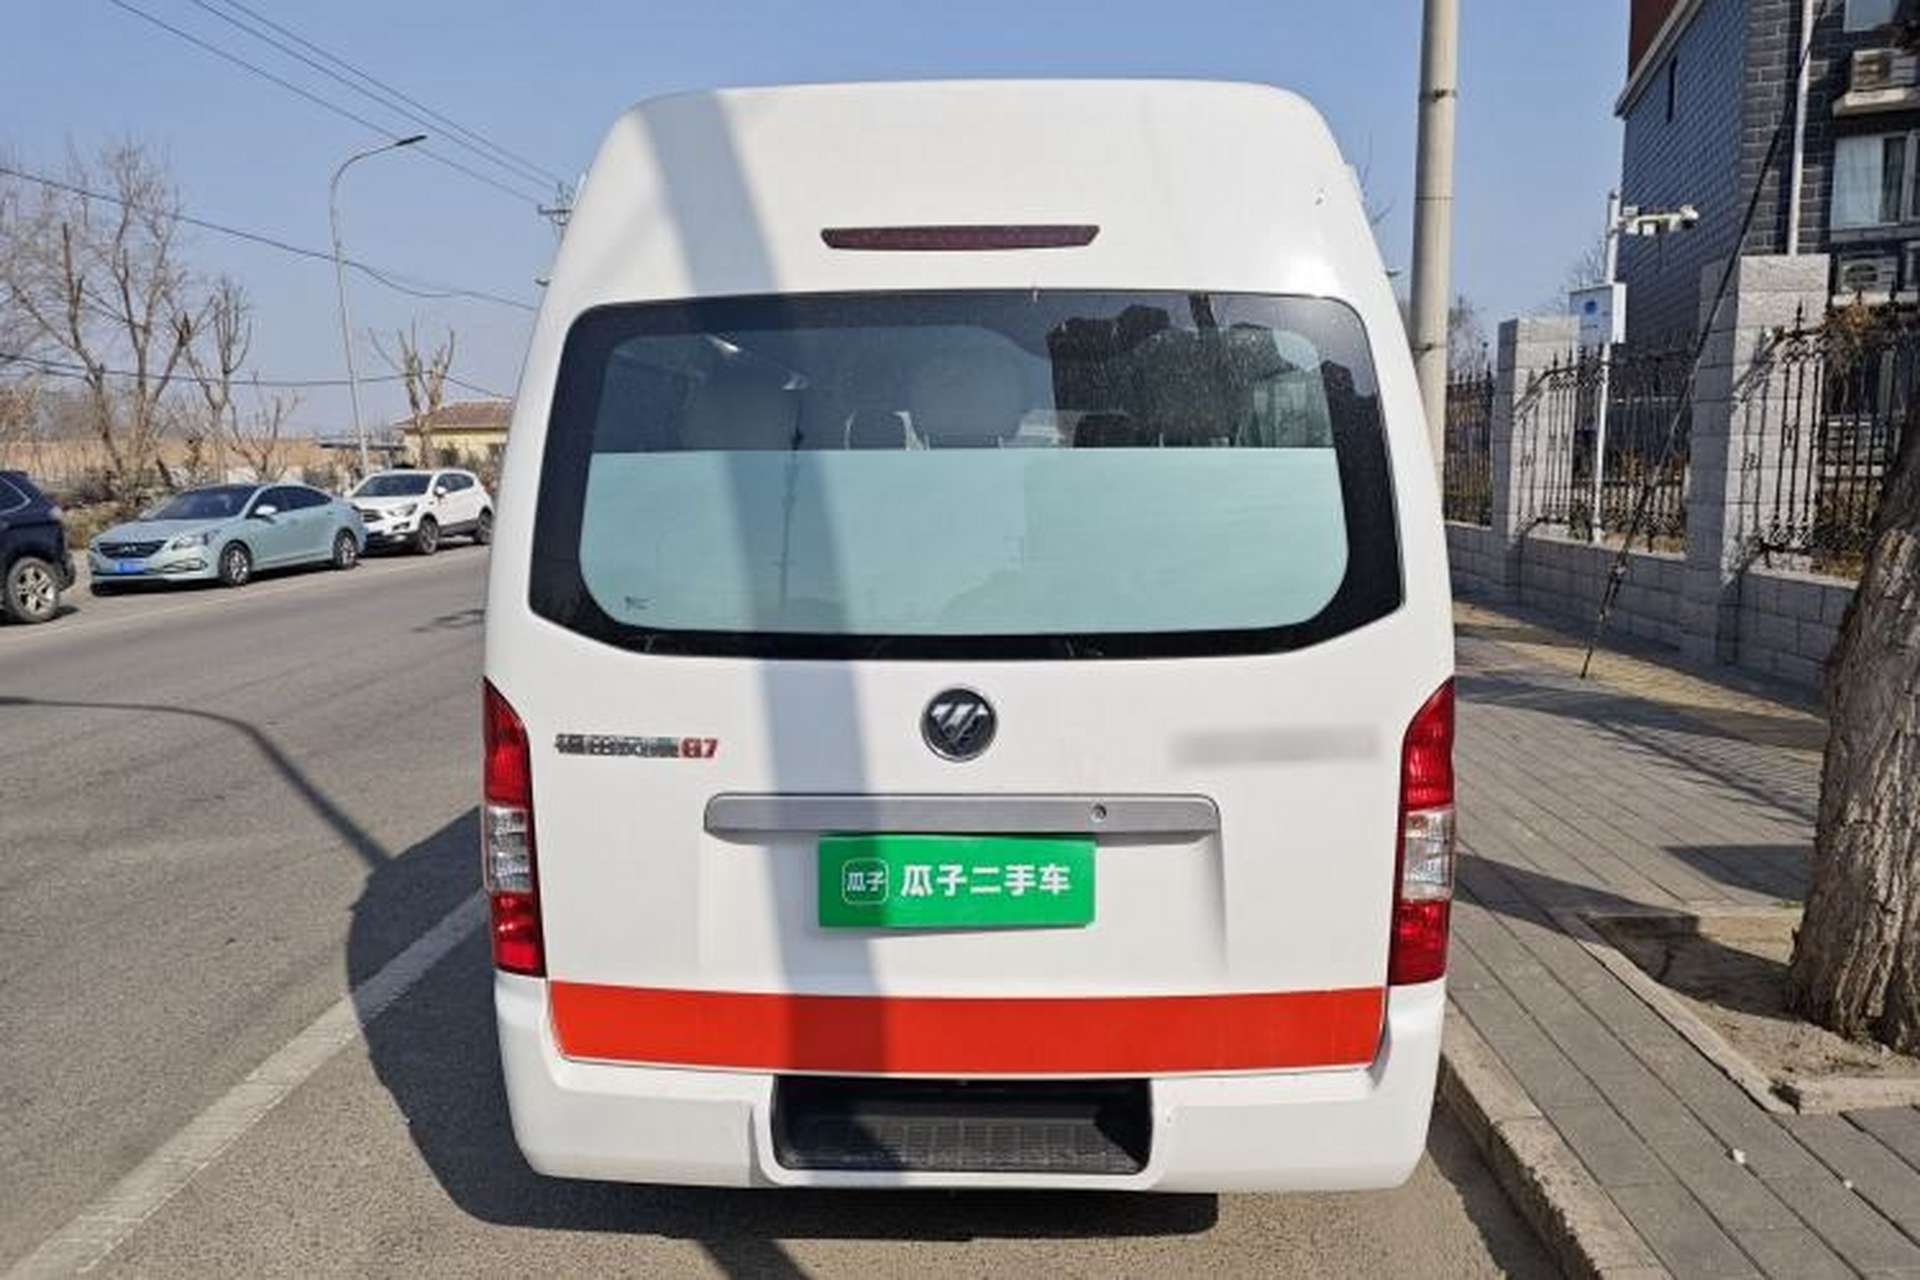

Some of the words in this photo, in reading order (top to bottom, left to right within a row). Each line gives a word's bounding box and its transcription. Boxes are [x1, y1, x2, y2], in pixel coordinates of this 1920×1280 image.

[847, 871, 885, 892] 瓜子
[901, 863, 1071, 897] 瓜子二手车
